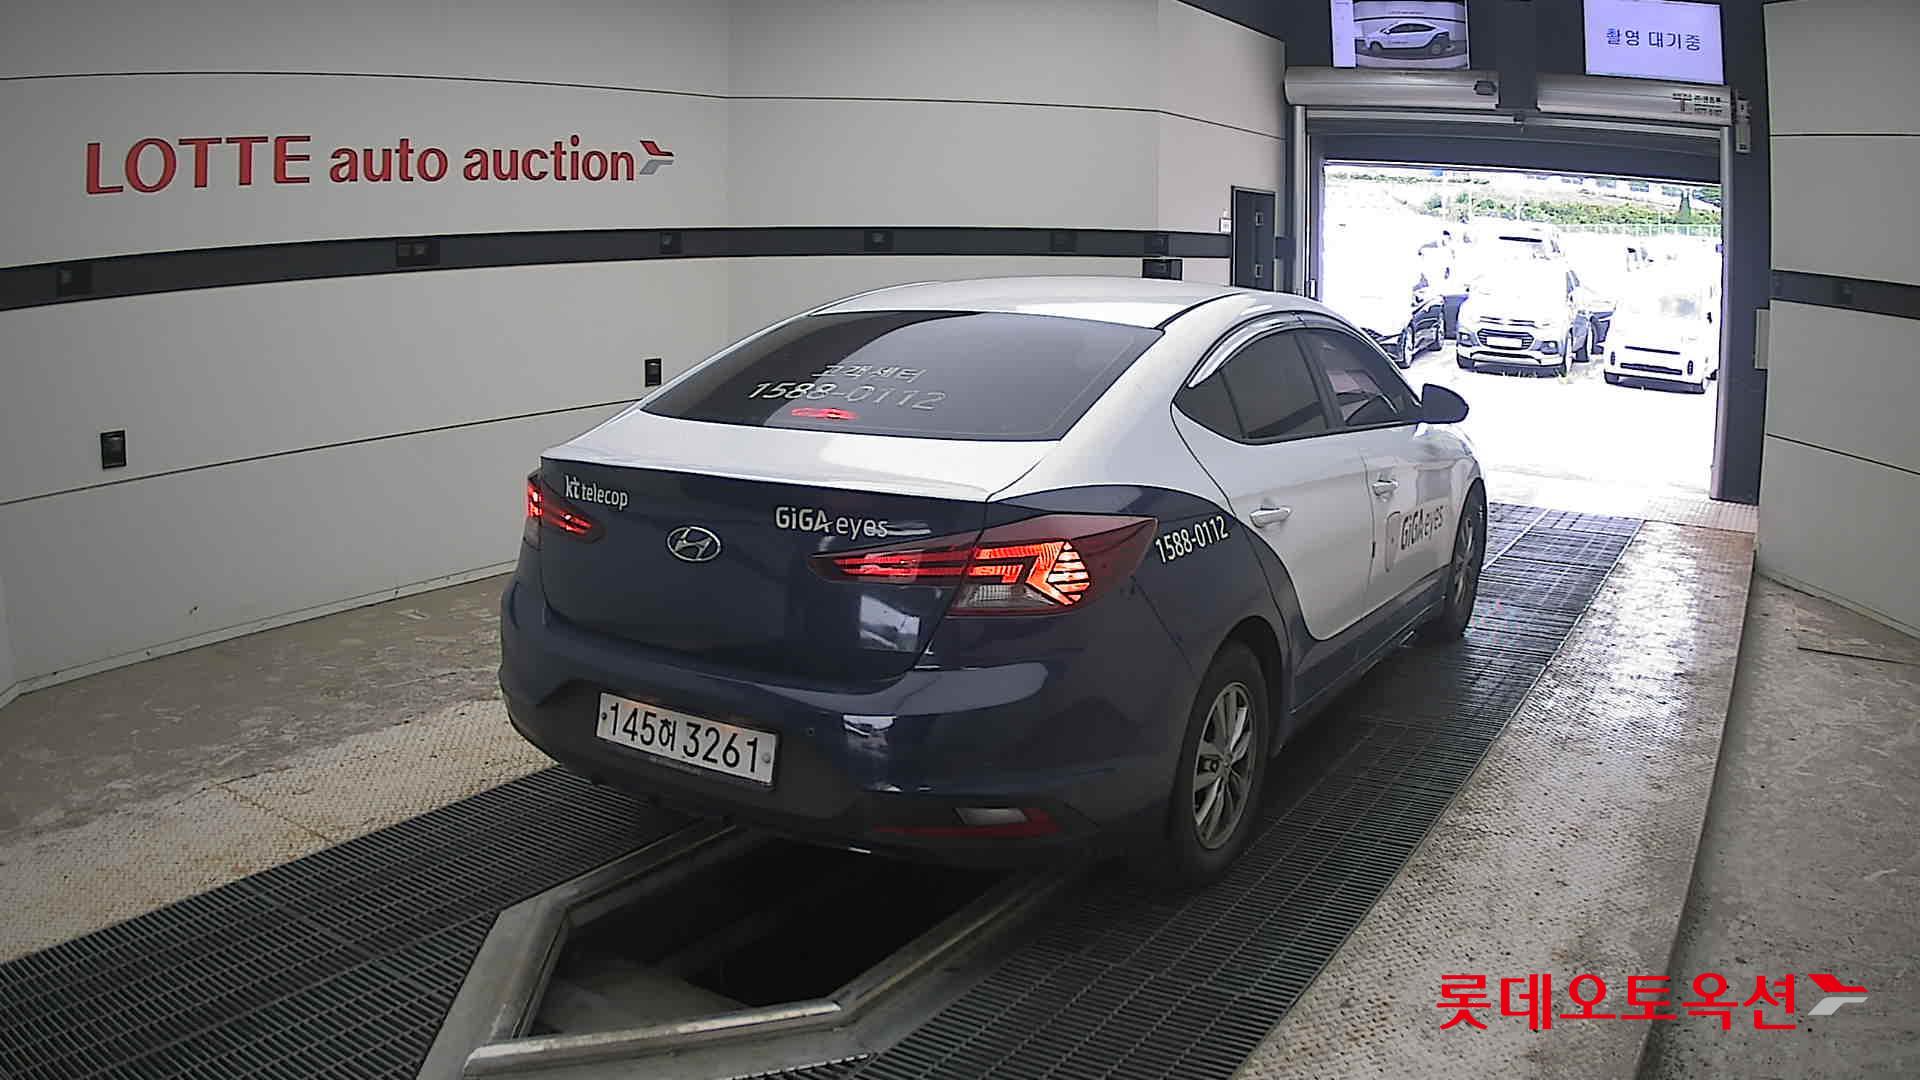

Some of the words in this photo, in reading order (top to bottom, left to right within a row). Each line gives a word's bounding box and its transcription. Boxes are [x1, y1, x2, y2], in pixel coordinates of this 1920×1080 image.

[1648, 31, 1701, 51] 대기중
[85, 135, 311, 195] LOTTE
[329, 138, 448, 182] auto
[463, 134, 635, 181] auction
[748, 381, 946, 411] 1588-0112
[565, 475, 579, 499] kt
[581, 483, 629, 511] telecop
[775, 507, 832, 532] GiGA
[836, 515, 888, 541] eyes
[1155, 516, 1229, 563] 1588-0112
